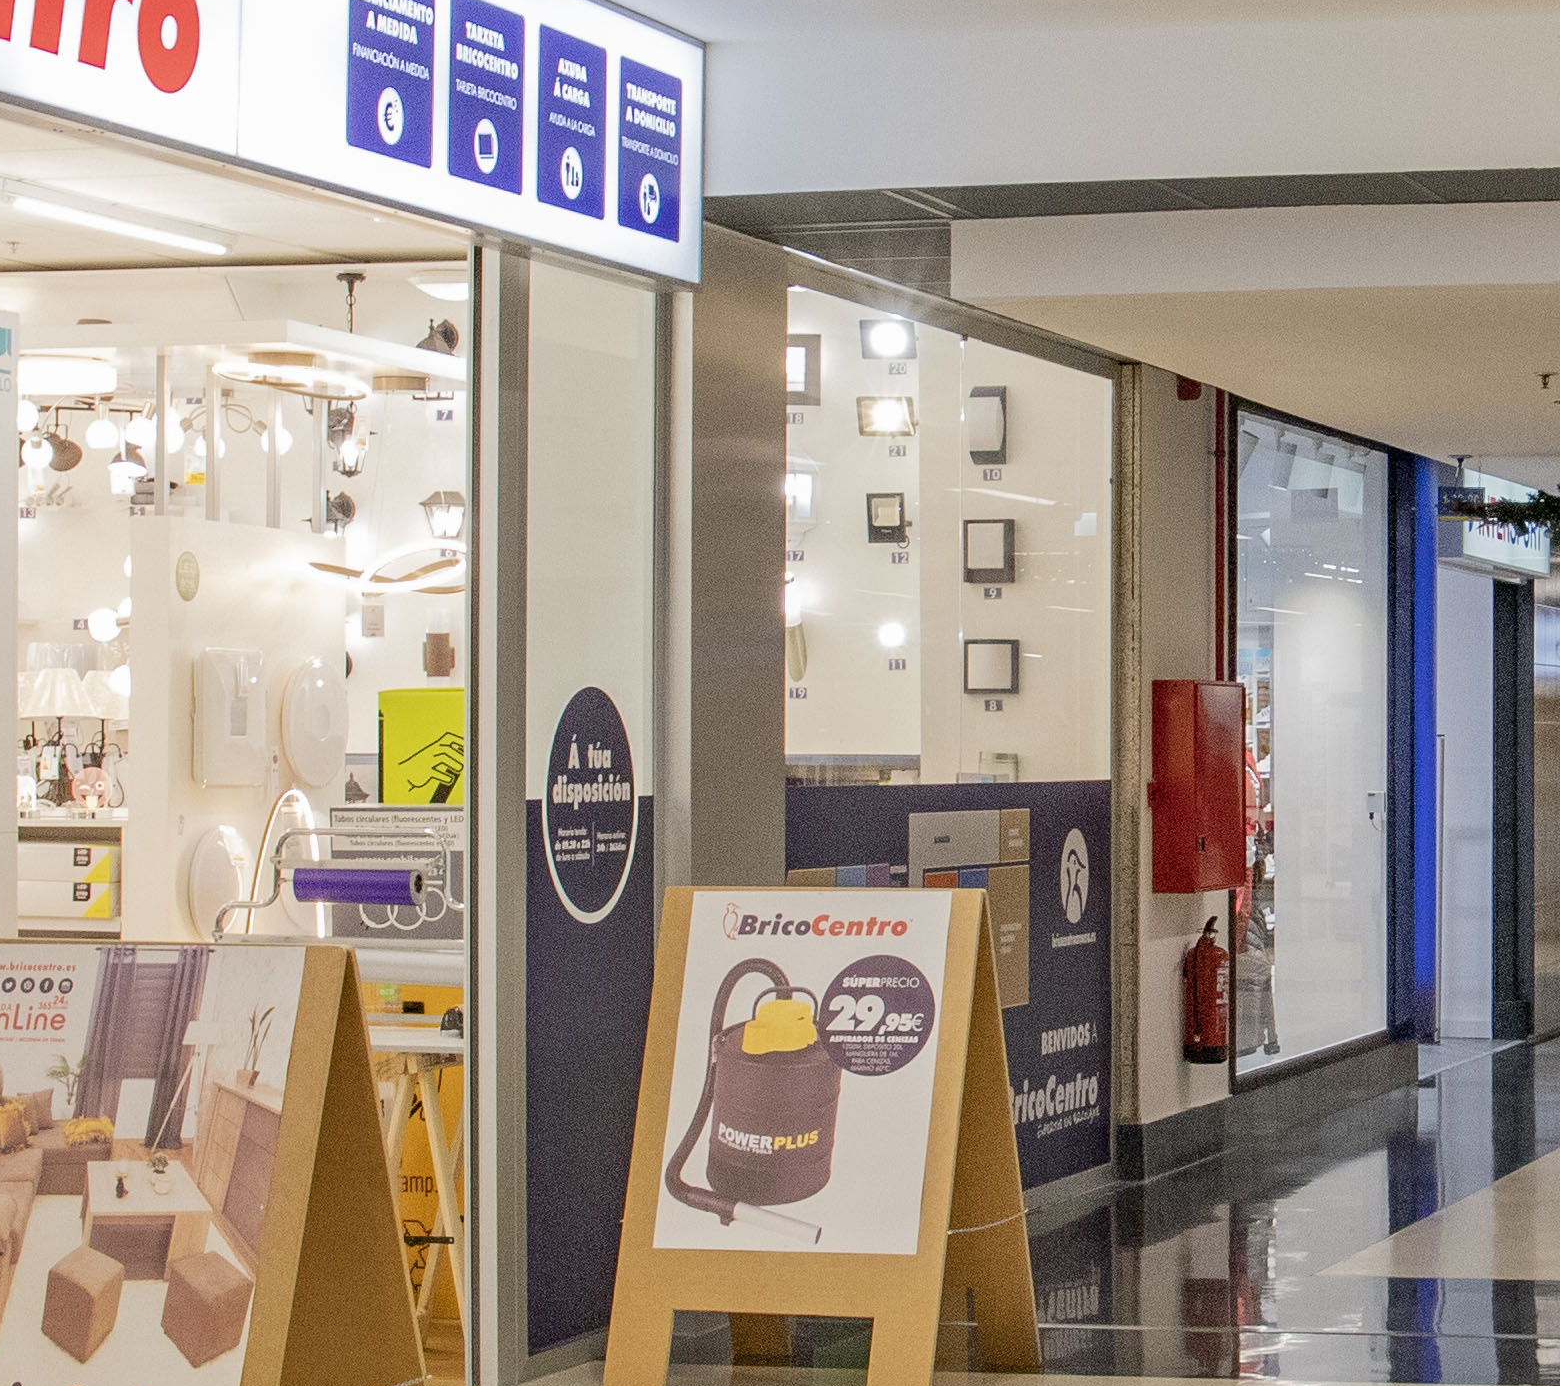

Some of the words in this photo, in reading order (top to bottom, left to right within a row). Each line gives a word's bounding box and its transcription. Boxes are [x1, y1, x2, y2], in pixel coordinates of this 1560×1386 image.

[366, 10, 377, 30] A
[377, 13, 419, 45] MEDIDA
[465, 21, 505, 52] TARXETA
[406, 60, 430, 81] MEDIDA
[455, 42, 519, 81] BRICOCENTRO
[455, 77, 477, 99] TARJETA
[477, 82, 518, 111] BRICOCENTRO
[562, 84, 591, 109] CARGA
[626, 81, 677, 116] TRANSPORTE
[625, 106, 633, 124] A
[633, 107, 677, 139] DOMICILIO
[891, 363, 906, 374] 20
[788, 413, 803, 424] 18
[890, 446, 906, 456] 21
[985, 469, 1000, 480] 10
[788, 551, 803, 561] 17
[893, 552, 908, 563] 12
[890, 659, 905, 670] 11
[791, 688, 806, 698] 19
[567, 733, 580, 769] Á
[587, 741, 612, 769] túa
[552, 774, 631, 810] disposición
[356, 814, 389, 823] circulares
[737, 913, 909, 937] BricoCentro
[842, 974, 920, 989] SÚPERPRECIO
[825, 994, 924, 1035] 29,95€
[1041, 1022, 1091, 1055] BENVIDOS
